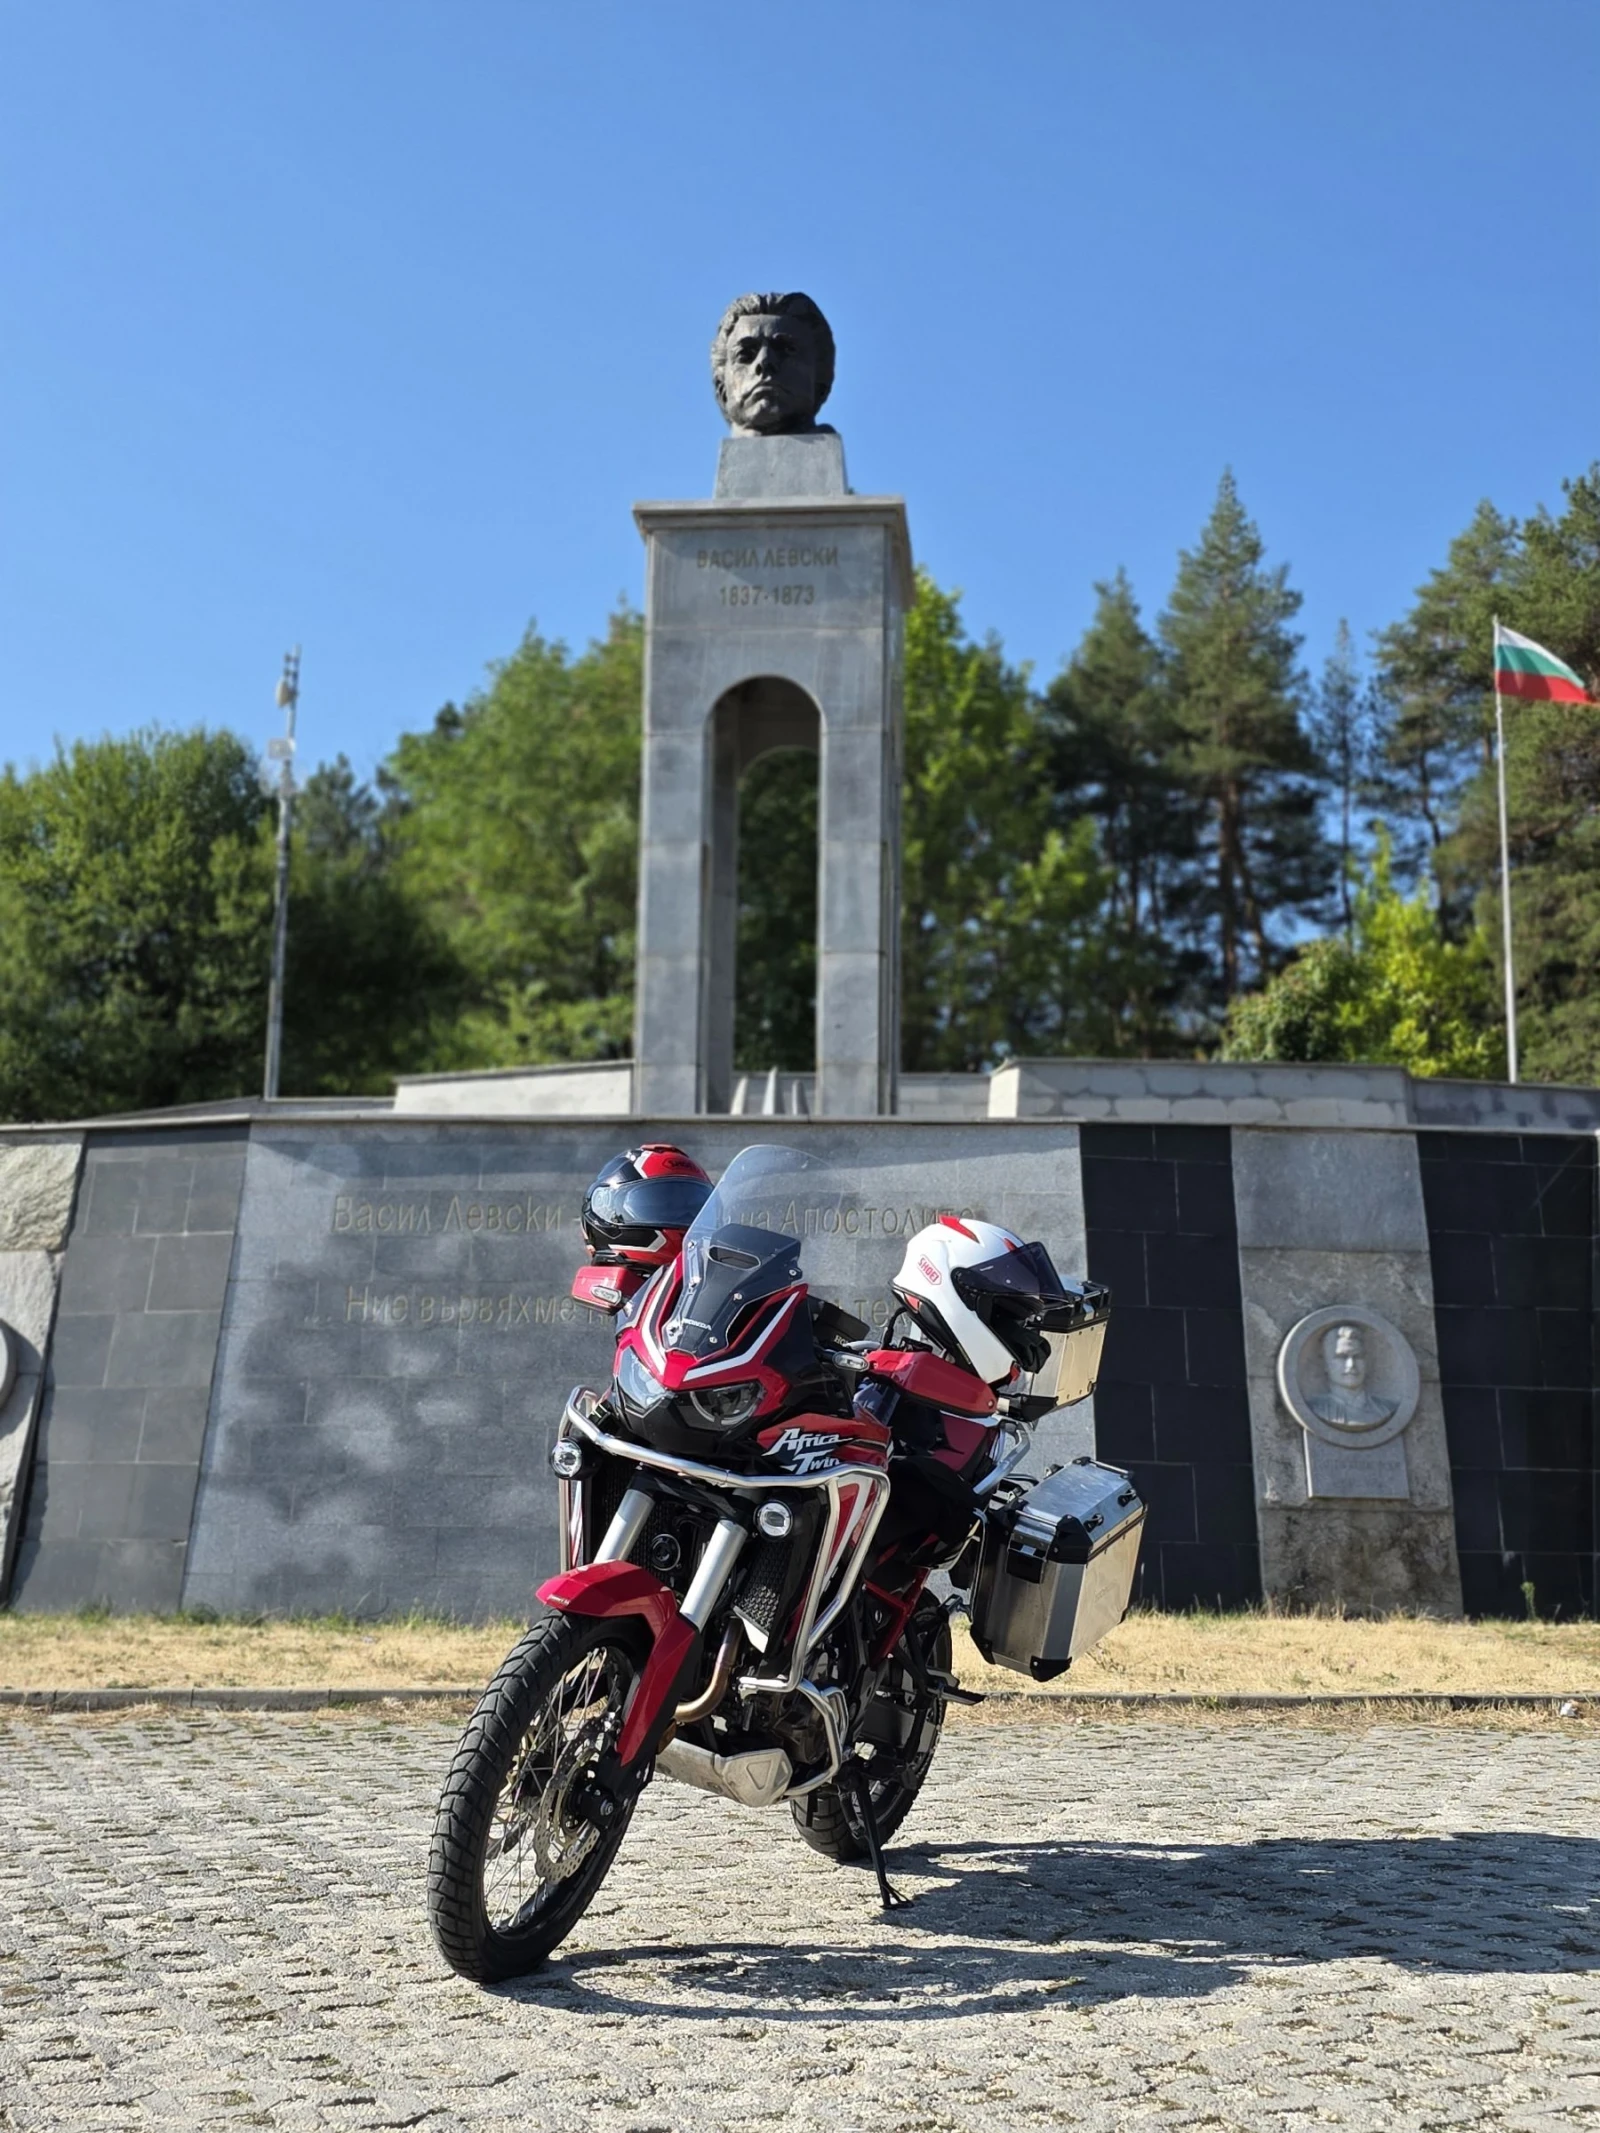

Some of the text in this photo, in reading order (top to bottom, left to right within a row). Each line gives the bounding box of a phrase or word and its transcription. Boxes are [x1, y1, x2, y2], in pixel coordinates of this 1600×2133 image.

[697, 546, 839, 569] ВАСИЛ ЛЕВСКИ
[331, 1194, 431, 1234] Васил
[442, 1195, 561, 1234] Левски
[917, 1257, 940, 1282] SHOEI
[345, 1285, 408, 1323] Ние
[419, 1293, 577, 1326] вървяхме
[680, 1317, 712, 1331] HONDA
[761, 1427, 854, 1456] Africa
[780, 1449, 841, 1475] Twin
